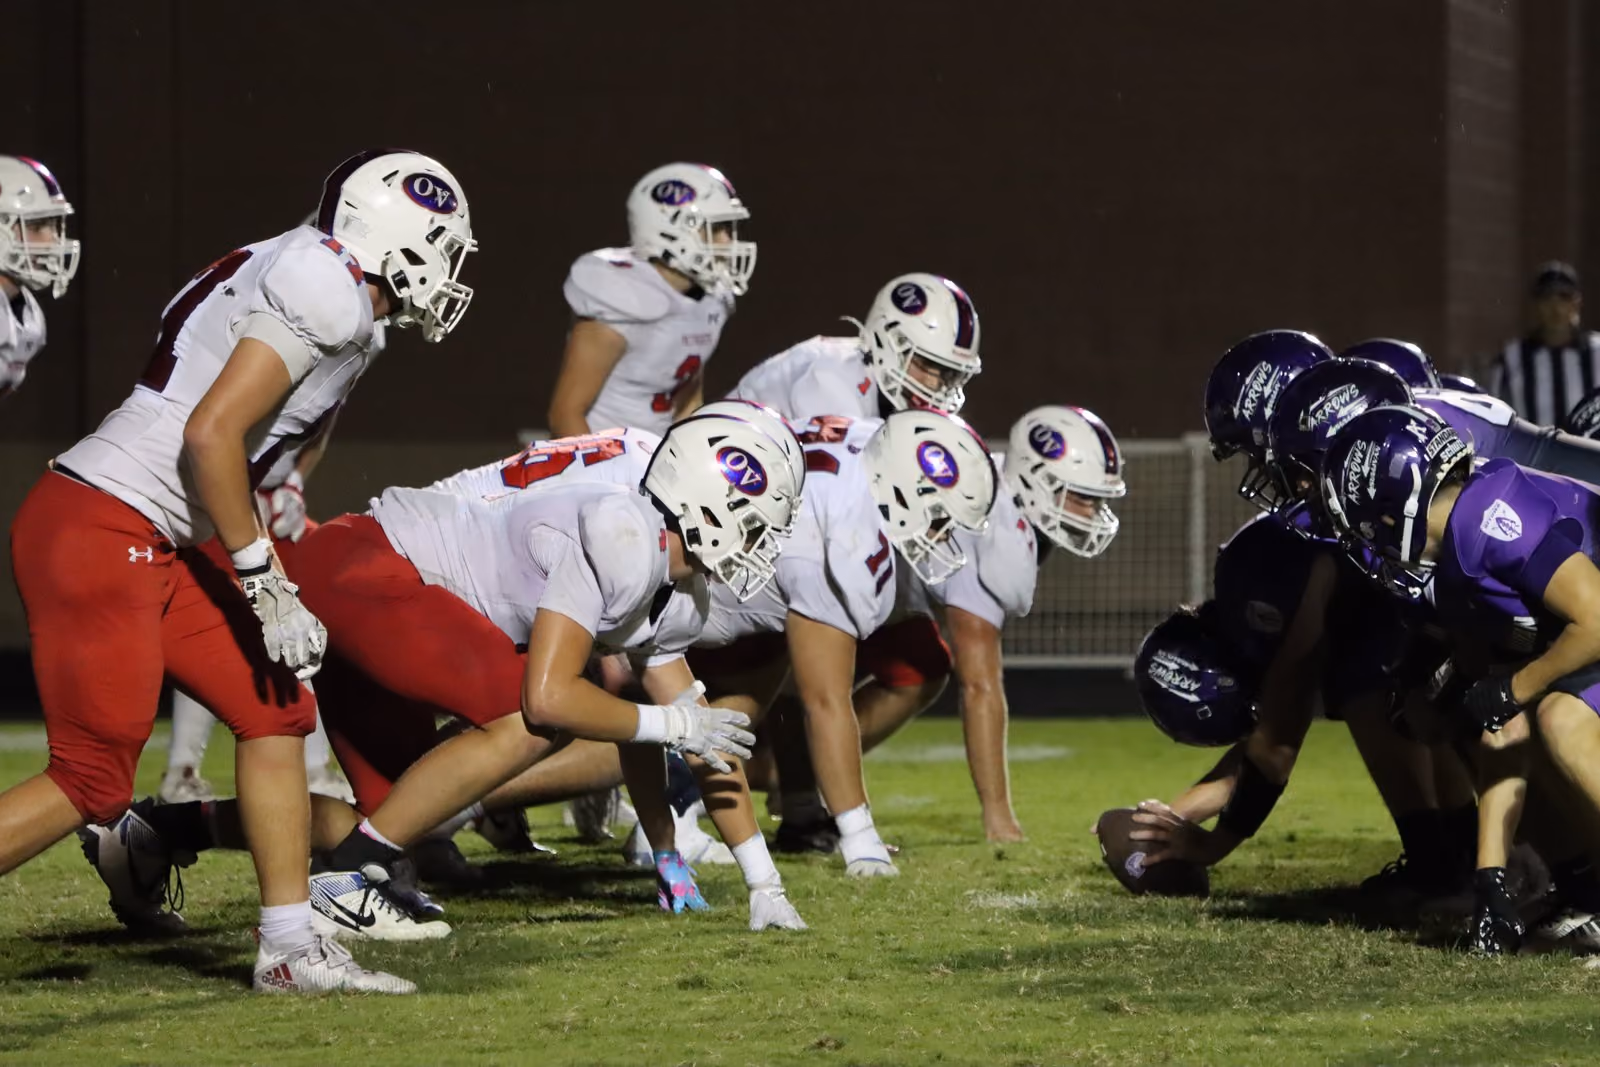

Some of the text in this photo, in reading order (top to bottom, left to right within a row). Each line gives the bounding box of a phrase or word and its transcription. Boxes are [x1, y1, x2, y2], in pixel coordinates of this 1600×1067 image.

[413, 177, 451, 208] OV
[656, 182, 690, 203] OV
[1242, 361, 1272, 421] ARROWS
[1310, 383, 1360, 432] ARROWS
[725, 451, 762, 486] OV
[1348, 439, 1367, 506] ARROWS
[1148, 662, 1201, 692] ARROWS
